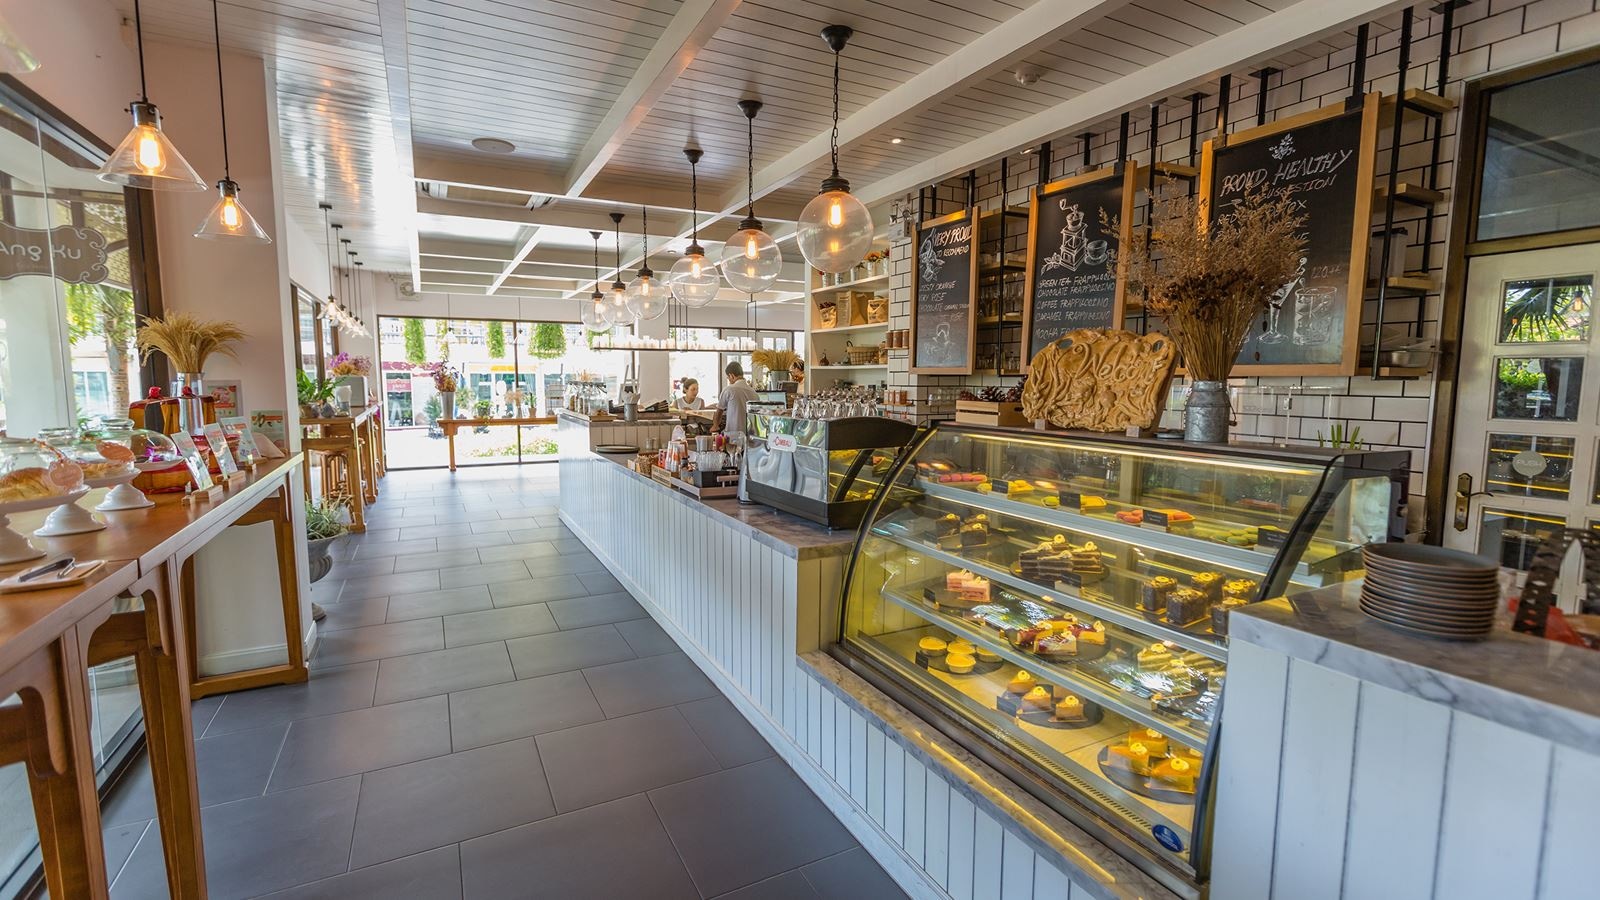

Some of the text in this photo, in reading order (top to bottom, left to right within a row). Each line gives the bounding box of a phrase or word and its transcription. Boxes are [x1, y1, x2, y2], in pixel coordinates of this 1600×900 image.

[1220, 149, 1353, 197] PROUD HEALTHY
[1261, 174, 1337, 198] UGGESTION
[932, 229, 951, 246] VERY
[51, 244, 81, 259] Ku
